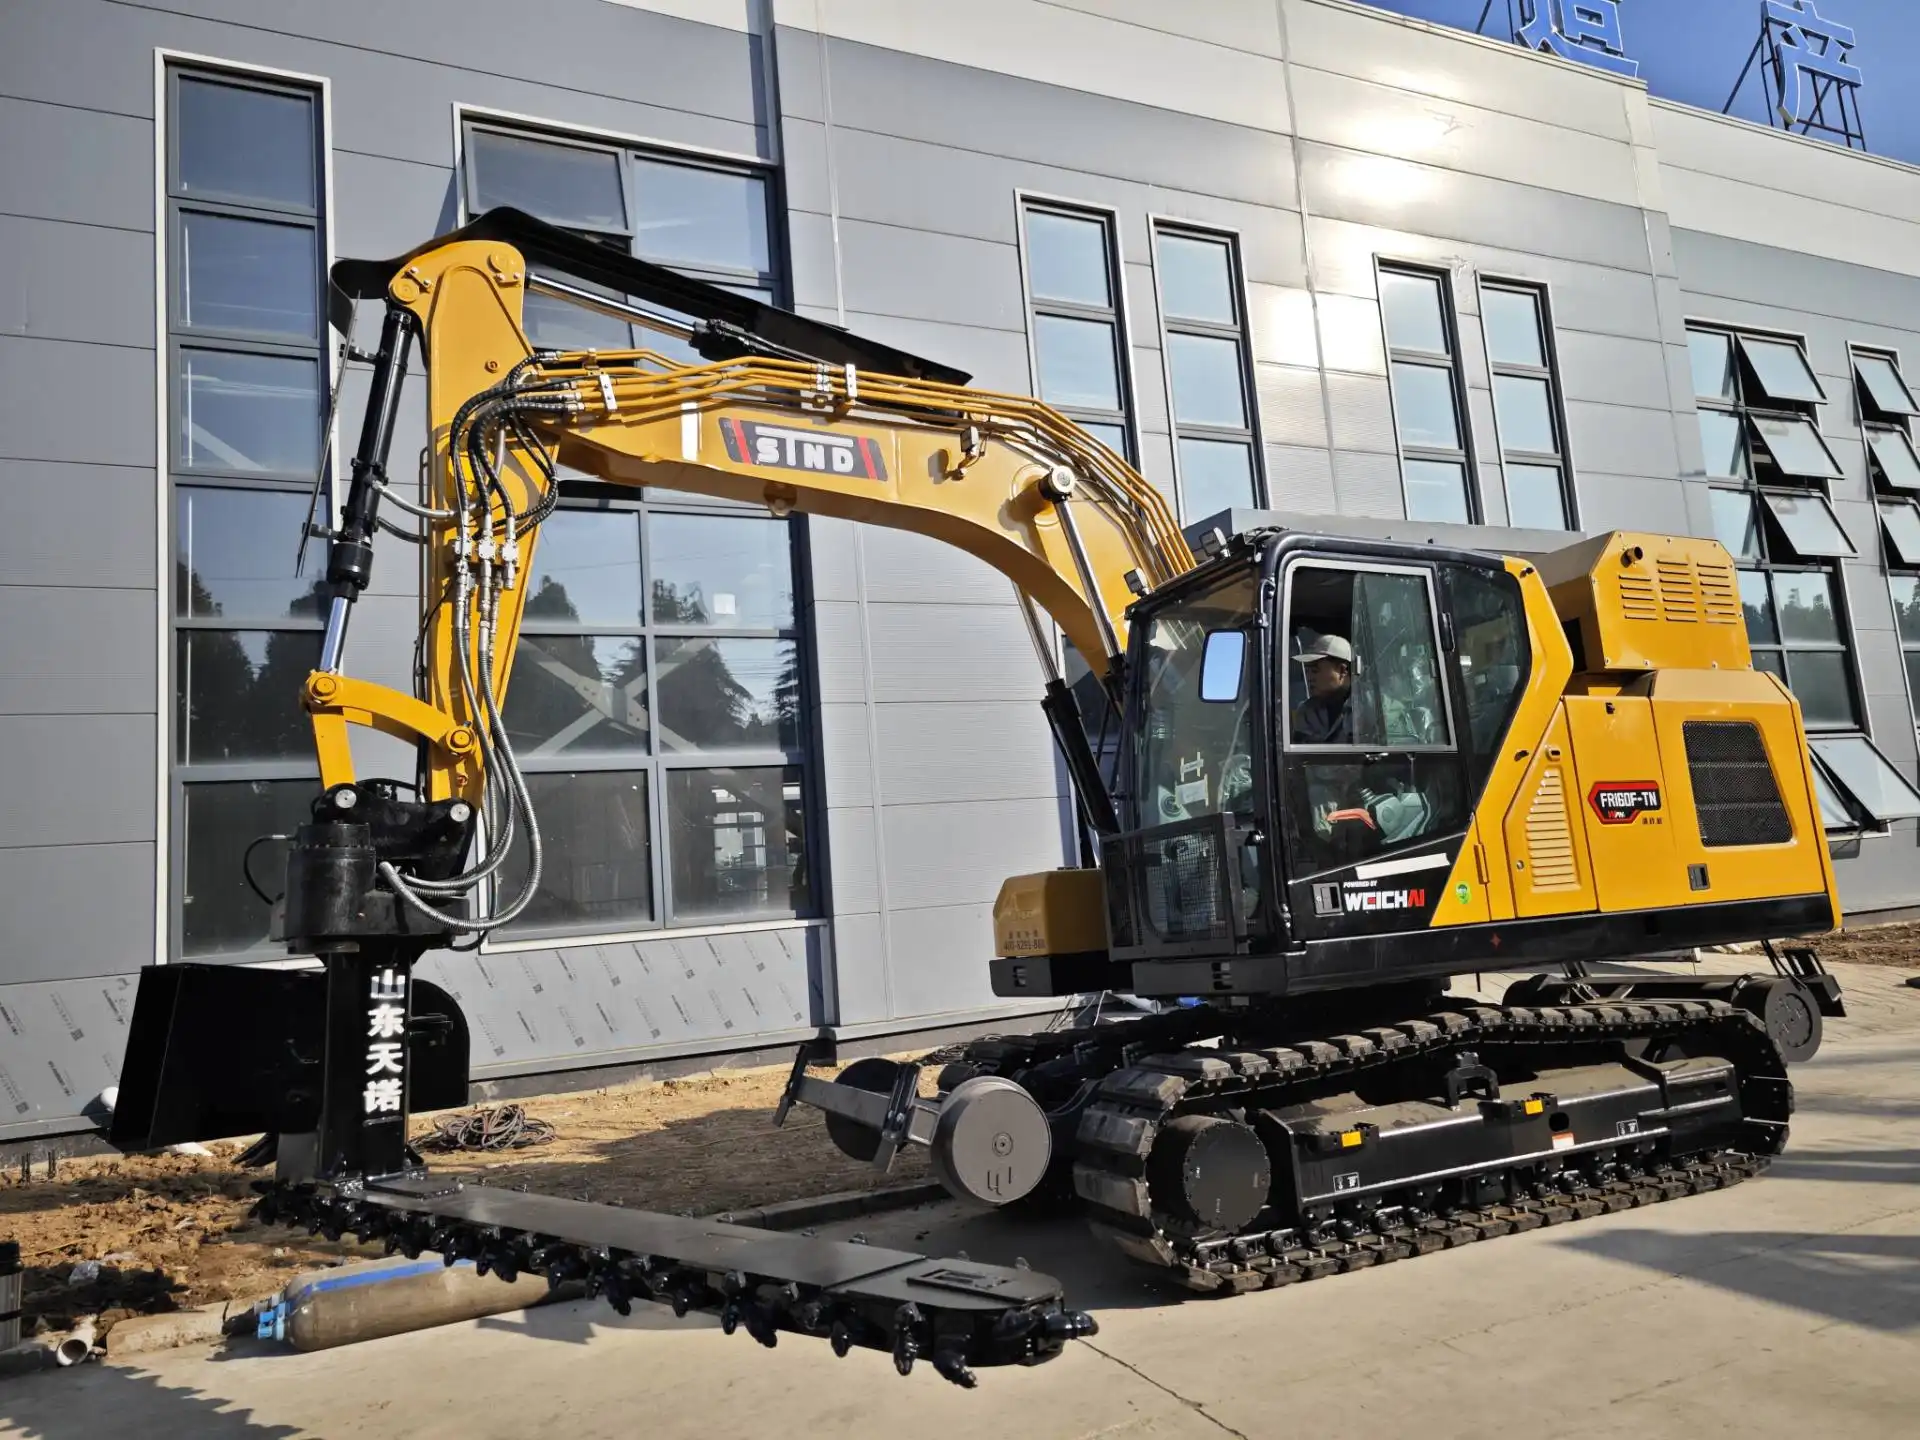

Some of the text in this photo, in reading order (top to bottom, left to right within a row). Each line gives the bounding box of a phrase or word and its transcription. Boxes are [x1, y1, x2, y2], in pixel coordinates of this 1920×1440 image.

[1344, 888, 1425, 912] WEICHAI
[362, 968, 406, 1115] 山东天诺
